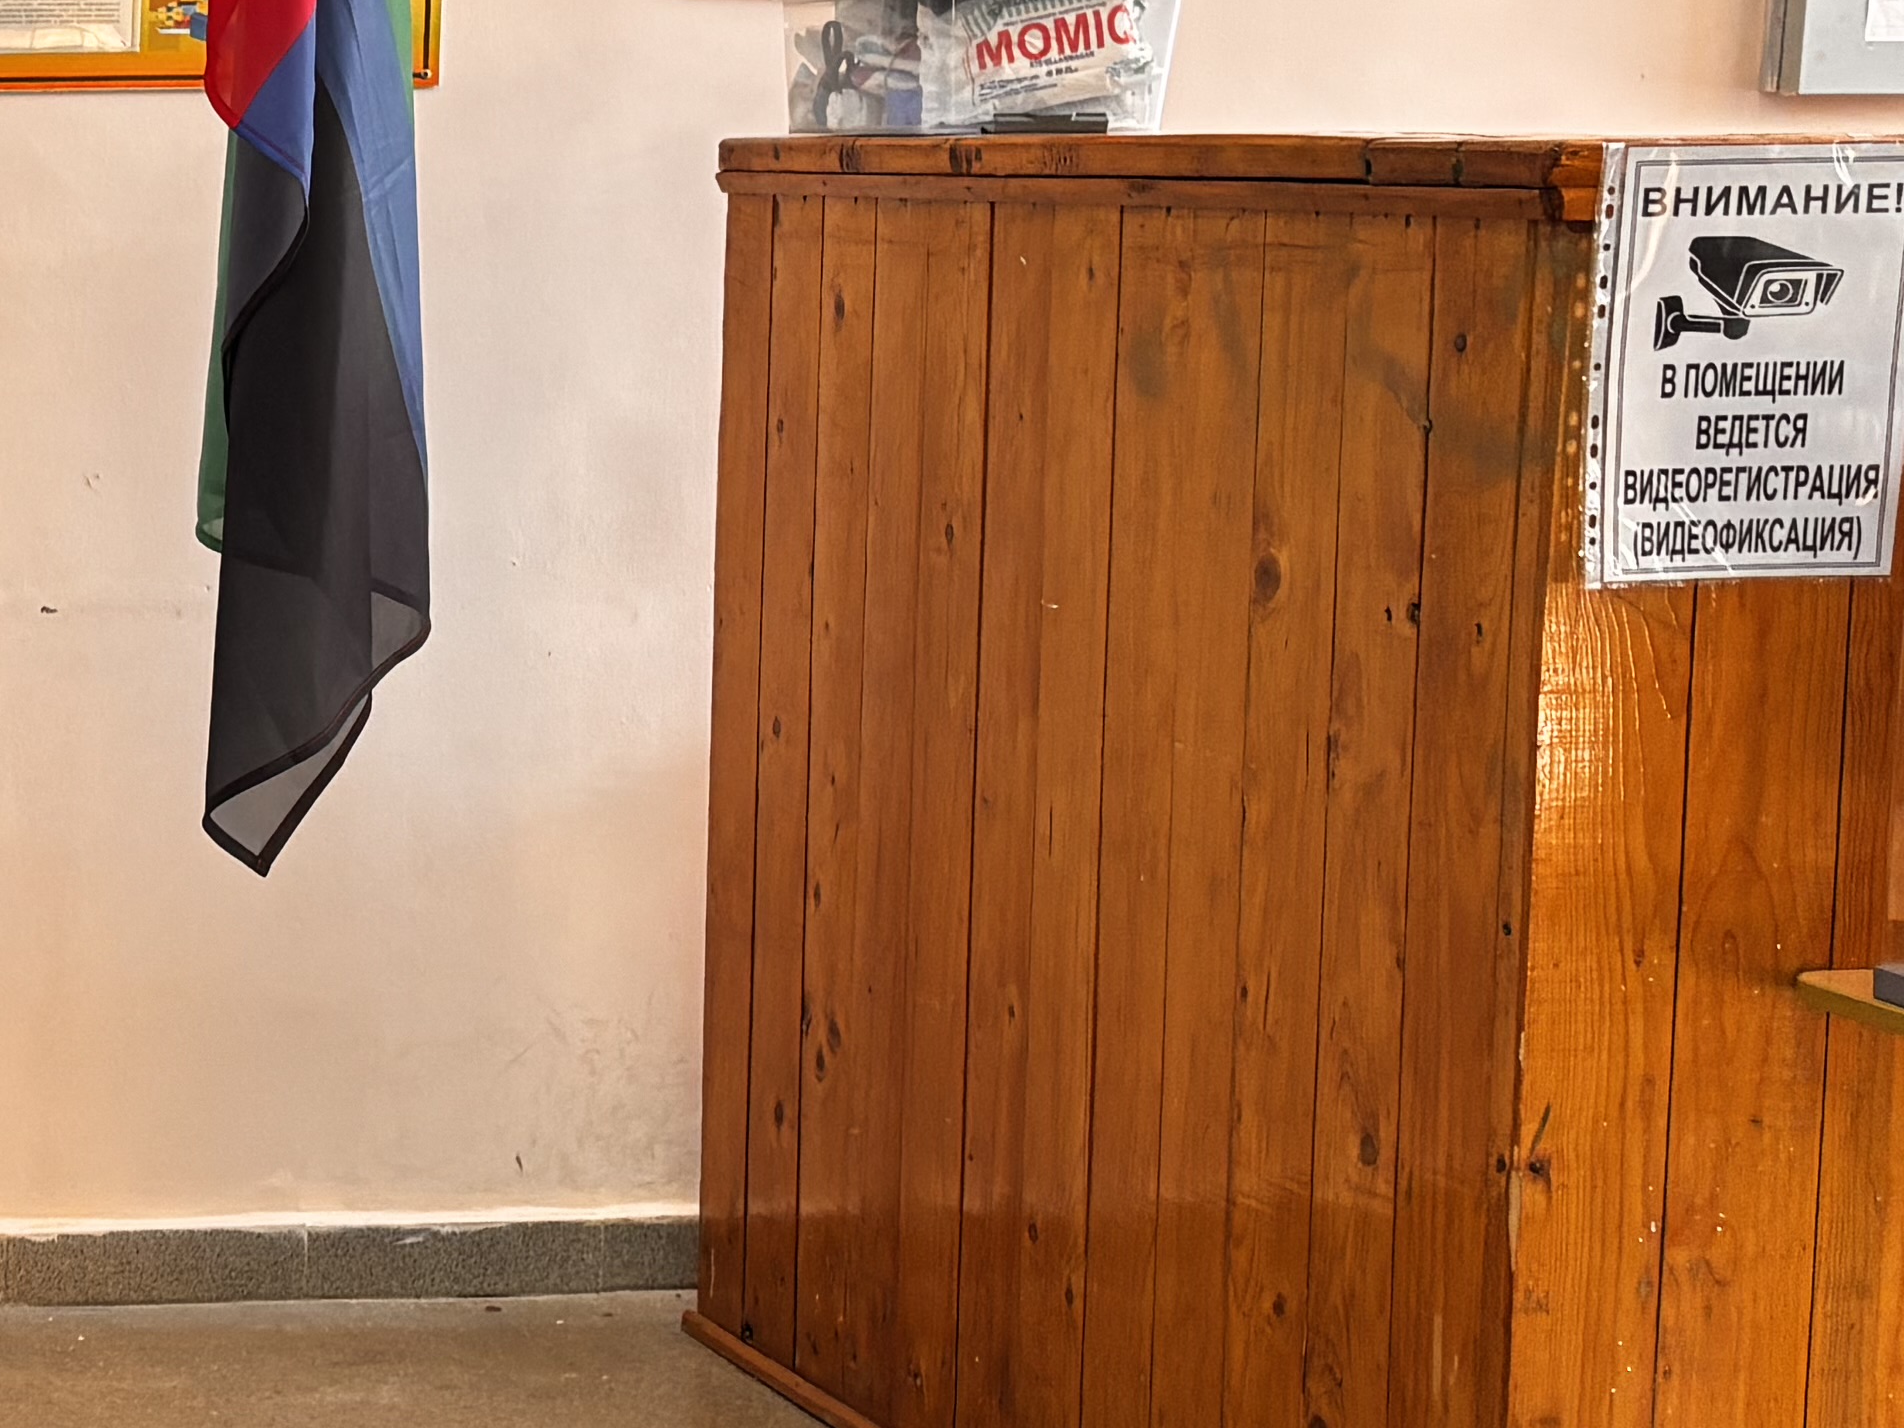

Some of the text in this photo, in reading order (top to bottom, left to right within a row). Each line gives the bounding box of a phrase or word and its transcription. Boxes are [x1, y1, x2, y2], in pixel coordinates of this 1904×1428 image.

[1641, 182, 1904, 218] ВНИМАНИЕ!
[1660, 360, 1845, 403] В ПОМЕЩЕНИИ
[1696, 413, 1808, 456] ВЕДЕТСЯ
[1623, 464, 1880, 511] ВИДЕОРЕГИСТРАЦИЯ
[1633, 515, 1862, 561] (ВИДЕОФИКСАЦИЯ)
